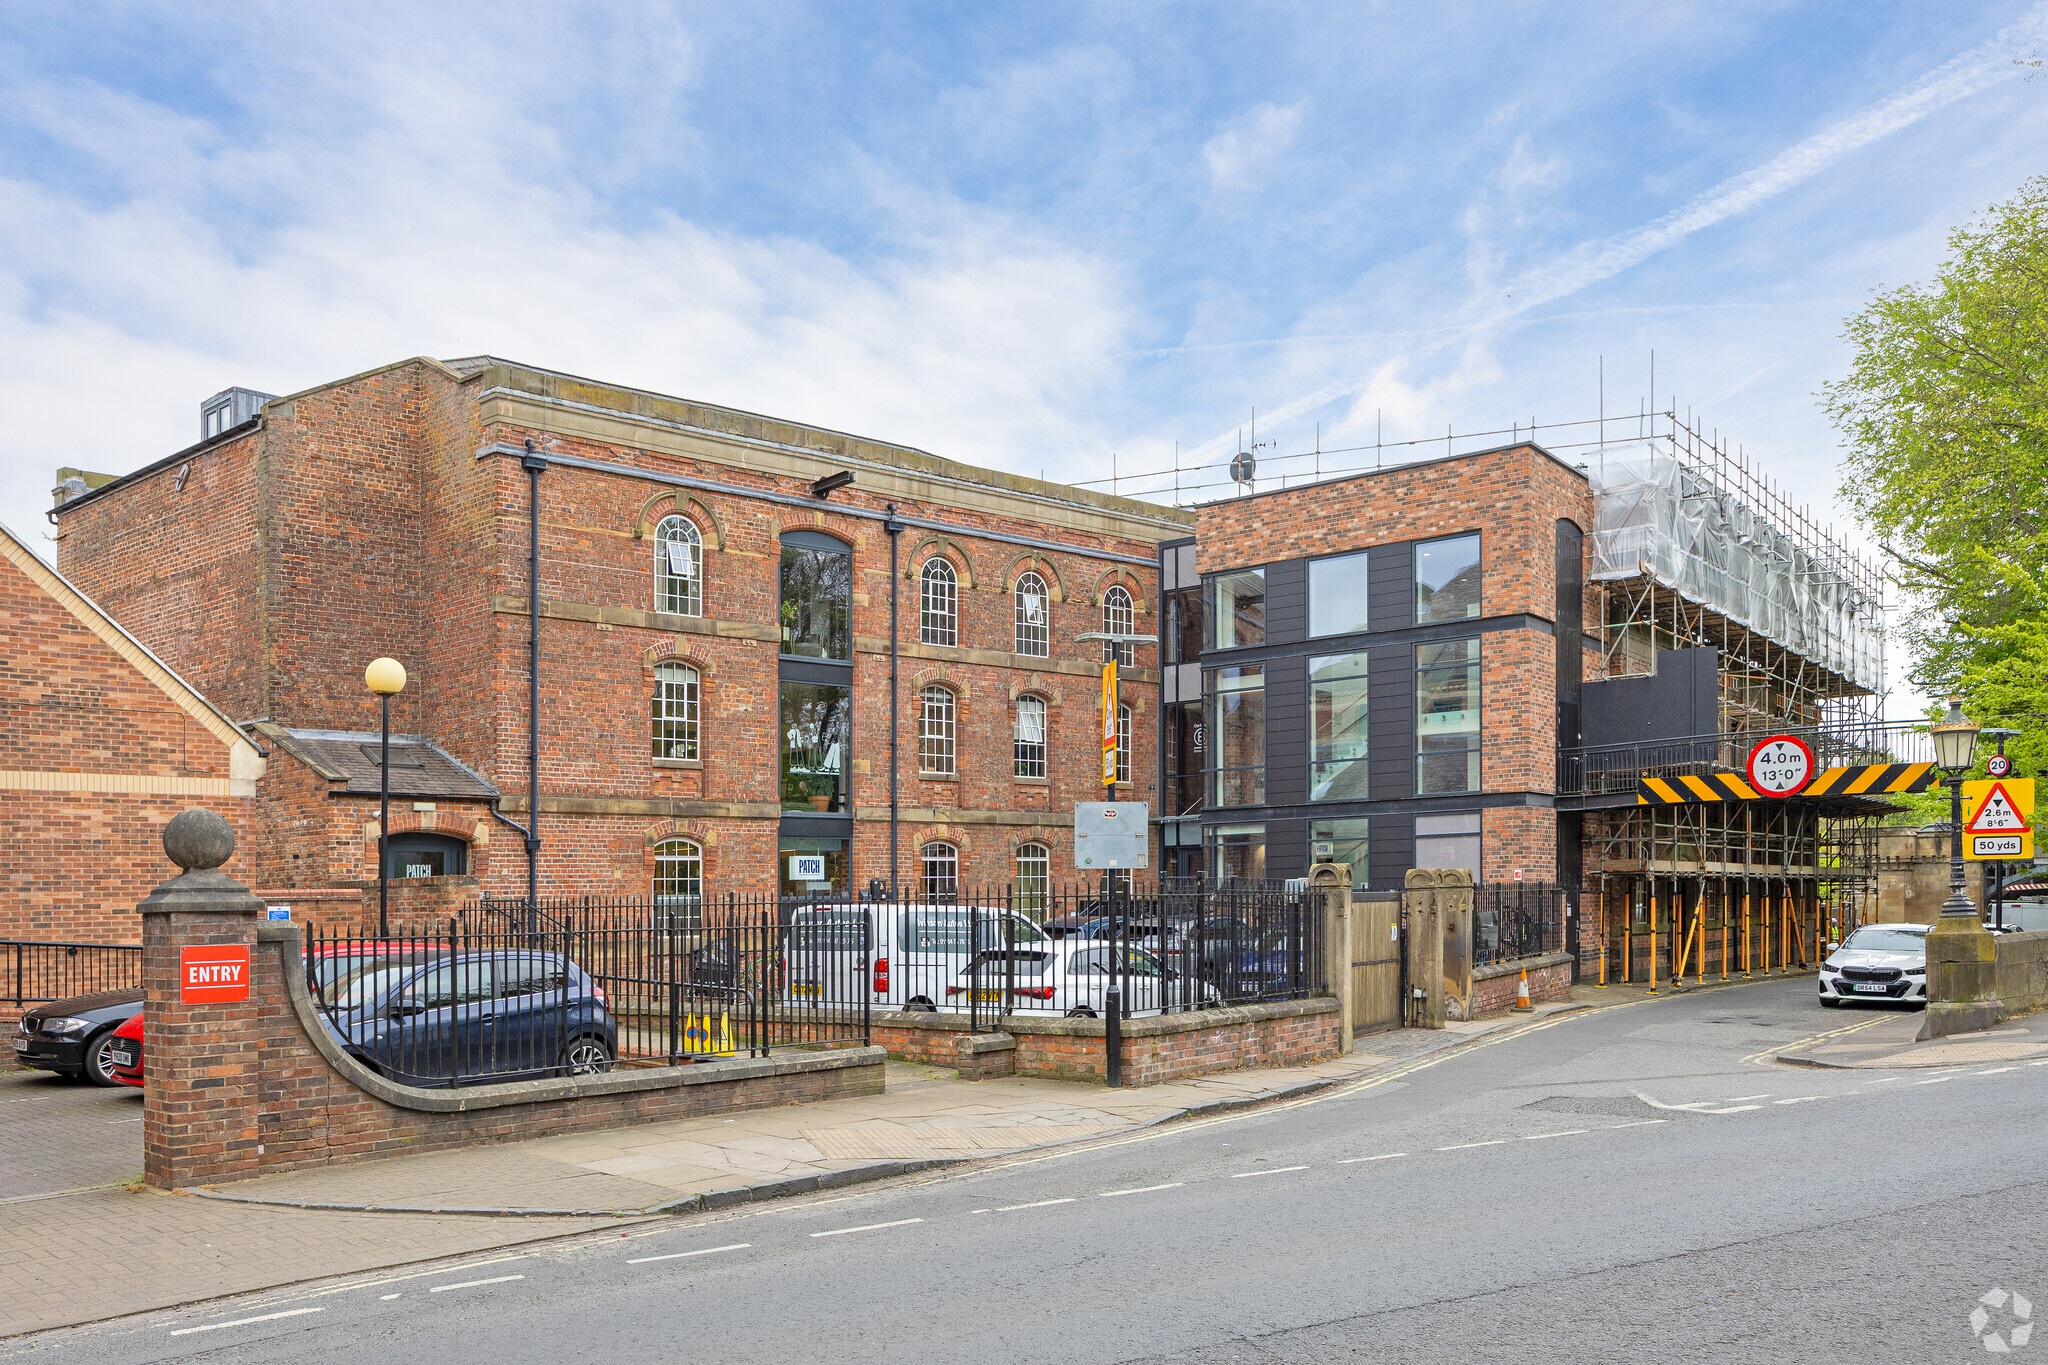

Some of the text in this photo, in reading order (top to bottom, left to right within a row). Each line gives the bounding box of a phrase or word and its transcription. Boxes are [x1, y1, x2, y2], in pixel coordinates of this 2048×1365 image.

[1991, 760, 2006, 770] 20
[1979, 841, 2016, 851] 50 yds
[406, 864, 431, 878] PATCH
[799, 859, 820, 873] PATCH
[189, 965, 242, 983] ENTRY
